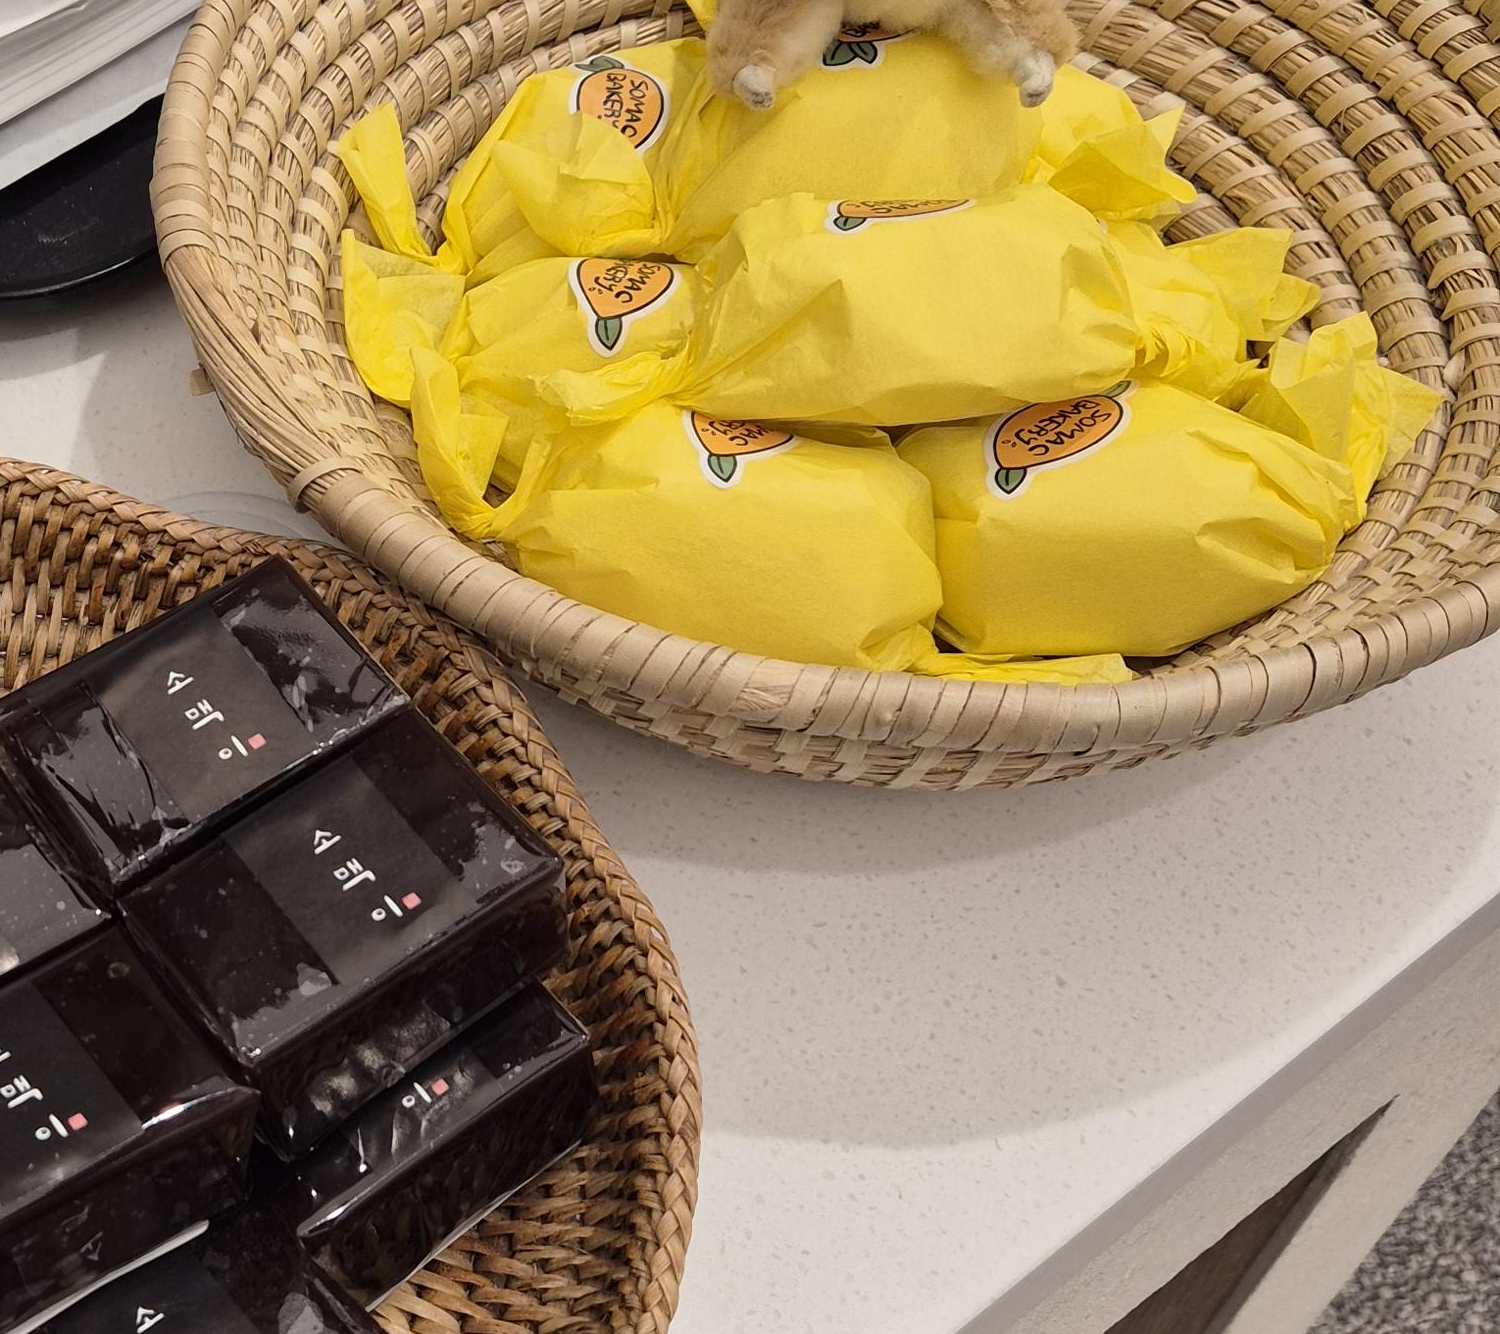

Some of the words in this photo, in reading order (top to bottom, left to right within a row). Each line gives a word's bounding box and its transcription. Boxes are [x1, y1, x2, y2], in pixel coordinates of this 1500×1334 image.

[603, 72, 627, 129] BAKER
[620, 78, 649, 139] SOMAC
[1014, 399, 1100, 446] BAKERY
[1028, 409, 1112, 456] SOMAC
[167, 671, 248, 760] 소맥이
[314, 829, 403, 921] 소맥이
